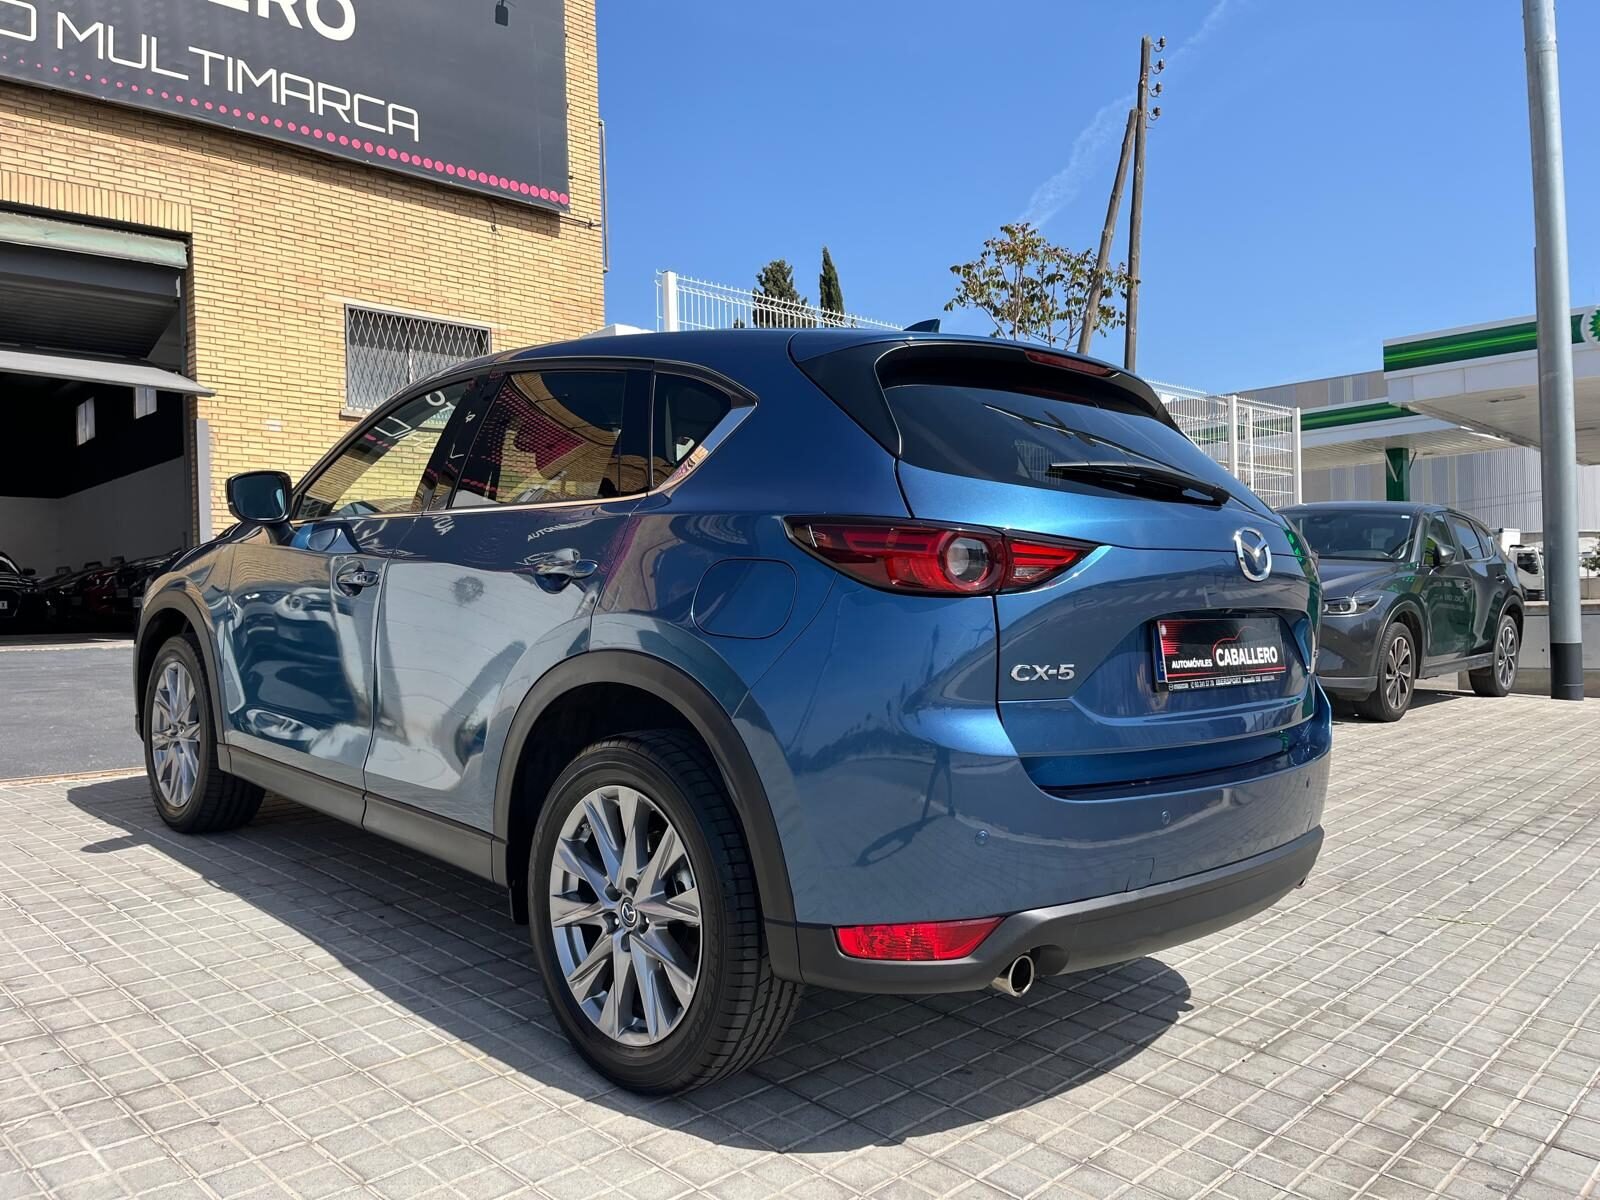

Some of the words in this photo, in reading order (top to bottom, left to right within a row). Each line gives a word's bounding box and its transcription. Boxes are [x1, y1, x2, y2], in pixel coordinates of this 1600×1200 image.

[56, 11, 420, 142] MULTIMARCA
[1171, 658, 1213, 669] AUTOMÓVILES
[1215, 646, 1278, 667] CABALLERO
[1010, 663, 1075, 682] CX-5
